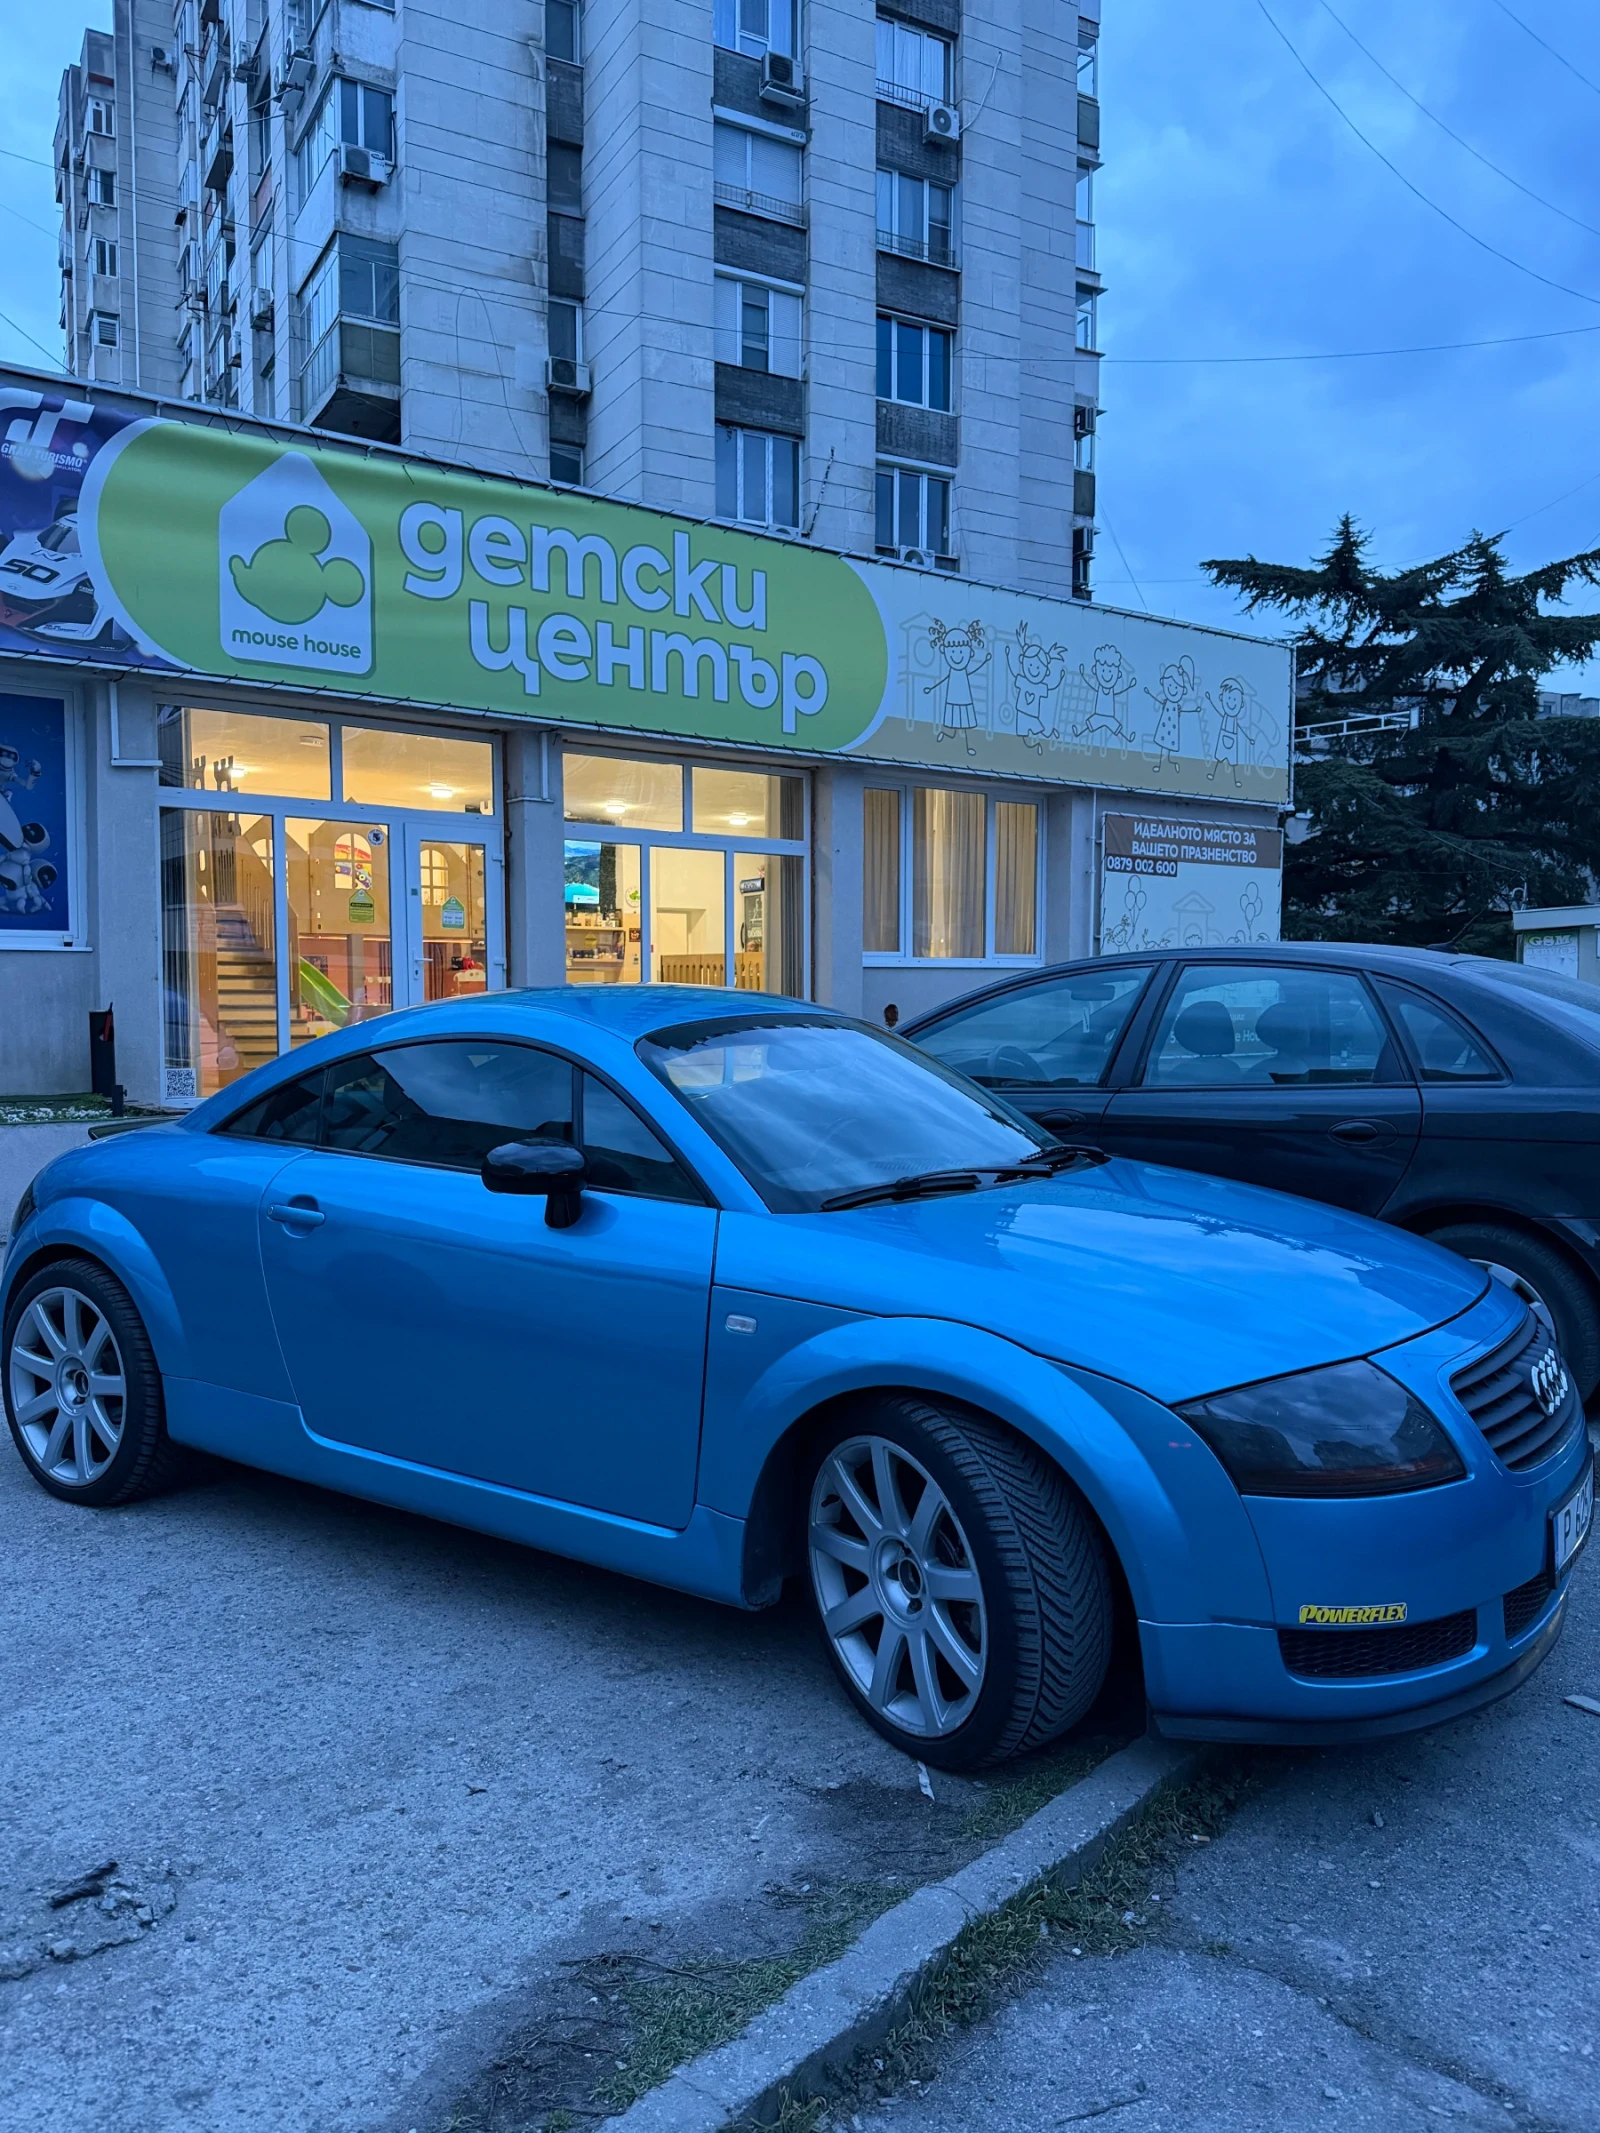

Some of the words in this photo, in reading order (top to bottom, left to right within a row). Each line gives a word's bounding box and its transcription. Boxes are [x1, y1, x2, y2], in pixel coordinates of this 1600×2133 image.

[399, 501, 767, 632] детски
[232, 629, 299, 650] mouse
[304, 634, 361, 659] house
[468, 599, 829, 735] център
[1134, 821, 1202, 841] ИДЕАЛНОТО
[1204, 829, 1241, 845] МЯСТО
[1243, 832, 1256, 846] ЗА
[1132, 842, 1179, 858] ВАШЕТО
[1180, 847, 1257, 864] ПРАЗНЕНСТВО
[1107, 855, 1133, 872] 0879
[1134, 859, 1154, 874] 002
[1156, 860, 1177, 875] 600
[1528, 934, 1572, 947] GSM
[1299, 1604, 1406, 1624] POWERFLEX
